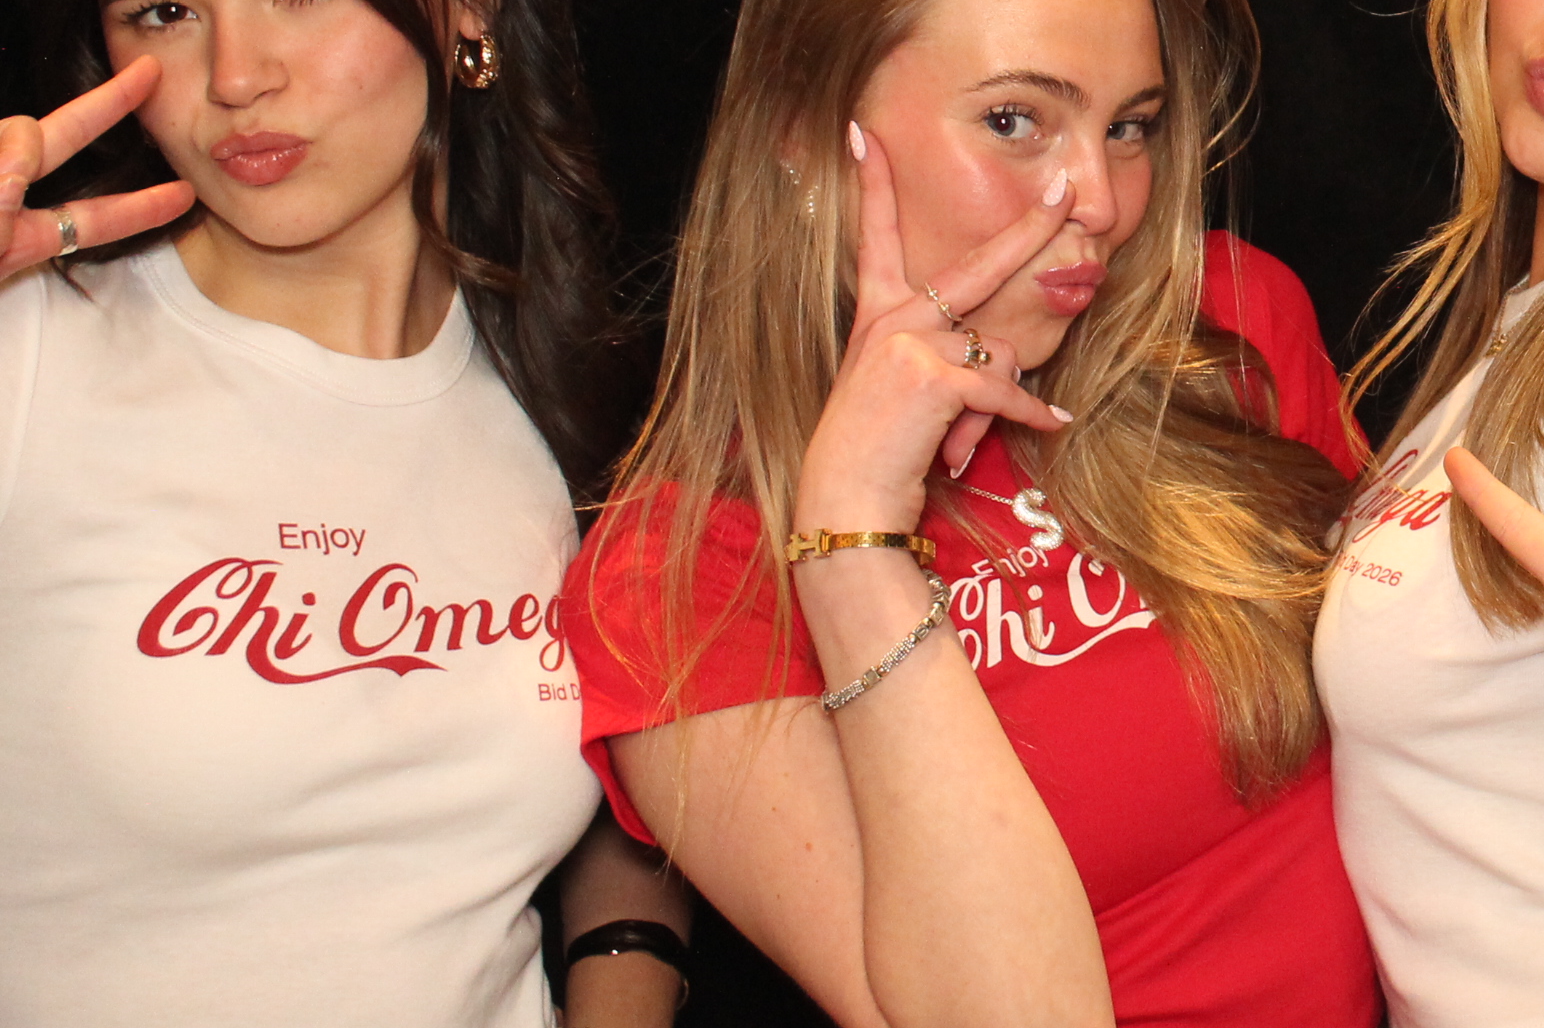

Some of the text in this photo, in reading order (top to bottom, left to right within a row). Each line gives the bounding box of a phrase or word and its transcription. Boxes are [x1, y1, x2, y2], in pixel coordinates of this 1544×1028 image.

[278, 523, 366, 555] Enjoy
[1361, 563, 1403, 586] 2026
[137, 557, 565, 684] Chi Omeg
[538, 683, 567, 701] Bid
